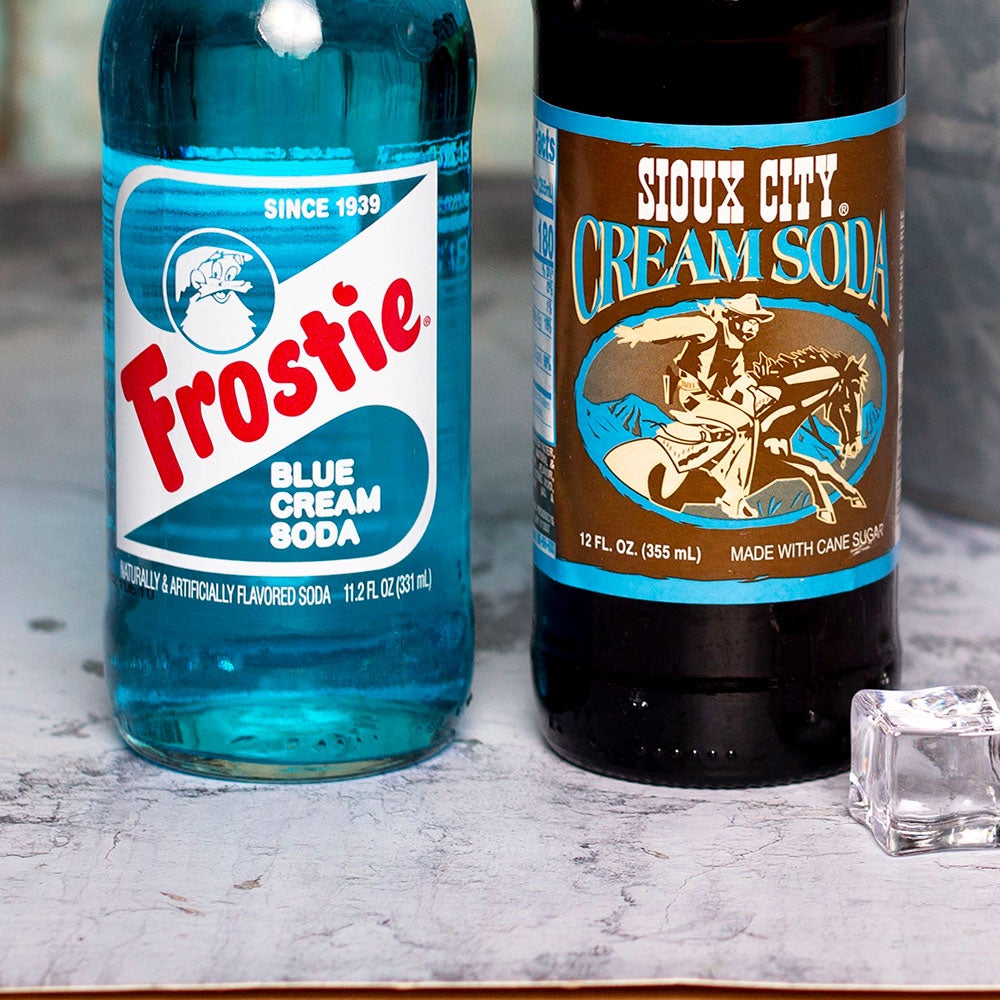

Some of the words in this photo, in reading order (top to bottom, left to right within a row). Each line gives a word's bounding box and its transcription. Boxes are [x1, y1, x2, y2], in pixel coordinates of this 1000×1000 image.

[264, 197, 329, 220] SINCE
[336, 194, 381, 217] 1939
[638, 156, 744, 225] SIOUX
[760, 153, 838, 223] CITY
[538, 218, 554, 259] 180
[572, 214, 764, 325] CREAM
[771, 207, 892, 328] SODA
[120, 277, 422, 494] Frostie
[270, 458, 354, 489] BLUE
[270, 485, 381, 519] CREAM
[270, 520, 360, 549] SODA
[579, 531, 592, 548] 12
[594, 535, 612, 552] FL.
[616, 538, 638, 556] OZ.
[641, 542, 671, 560] (355
[674, 545, 702, 564] mL)
[730, 544, 774, 561] MADE
[778, 541, 813, 559] WITH
[816, 534, 850, 555] CANE
[852, 523, 884, 548] SUGAR
[120, 559, 160, 591] NATURALLY
[161, 573, 169, 594] &
[170, 575, 235, 604] ARTIFICIALLY
[237, 584, 297, 606] FLAVORED
[298, 584, 332, 606] SODA
[344, 581, 365, 603] 11.2
[367, 579, 379, 600] FL
[380, 577, 394, 598] OZ
[395, 572, 415, 600] (331
[416, 567, 432, 592] mL)
